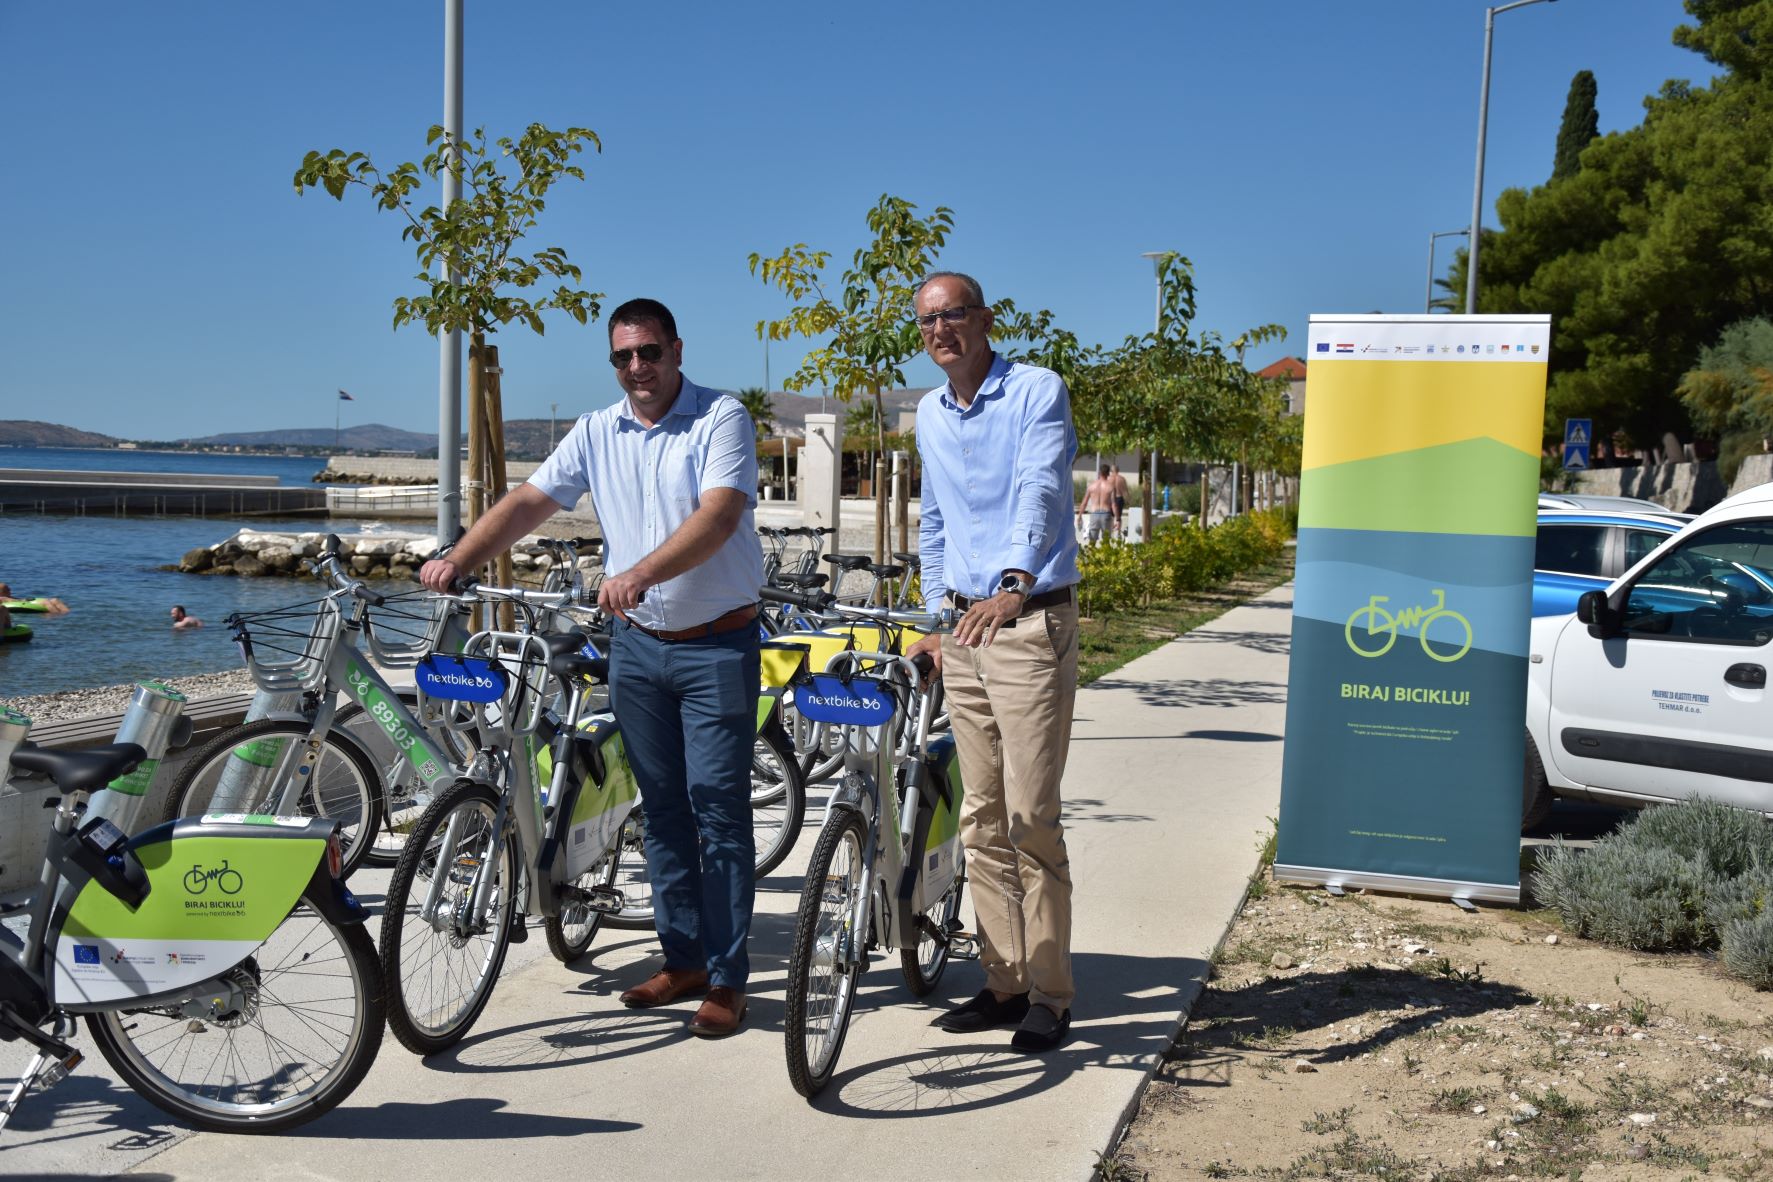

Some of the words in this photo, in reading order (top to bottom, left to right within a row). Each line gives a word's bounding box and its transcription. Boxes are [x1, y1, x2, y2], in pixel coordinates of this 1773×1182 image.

[427, 673, 475, 687] nextbike
[1341, 683, 1389, 702] BIRAJ
[1395, 687, 1470, 706] BICIKLU!
[808, 695, 861, 708] nextbike
[1658, 702, 1684, 712] TEHMAR
[371, 701, 416, 750] 89303
[185, 901, 208, 909] BIRAJ
[209, 901, 245, 909] BICIKLU!
